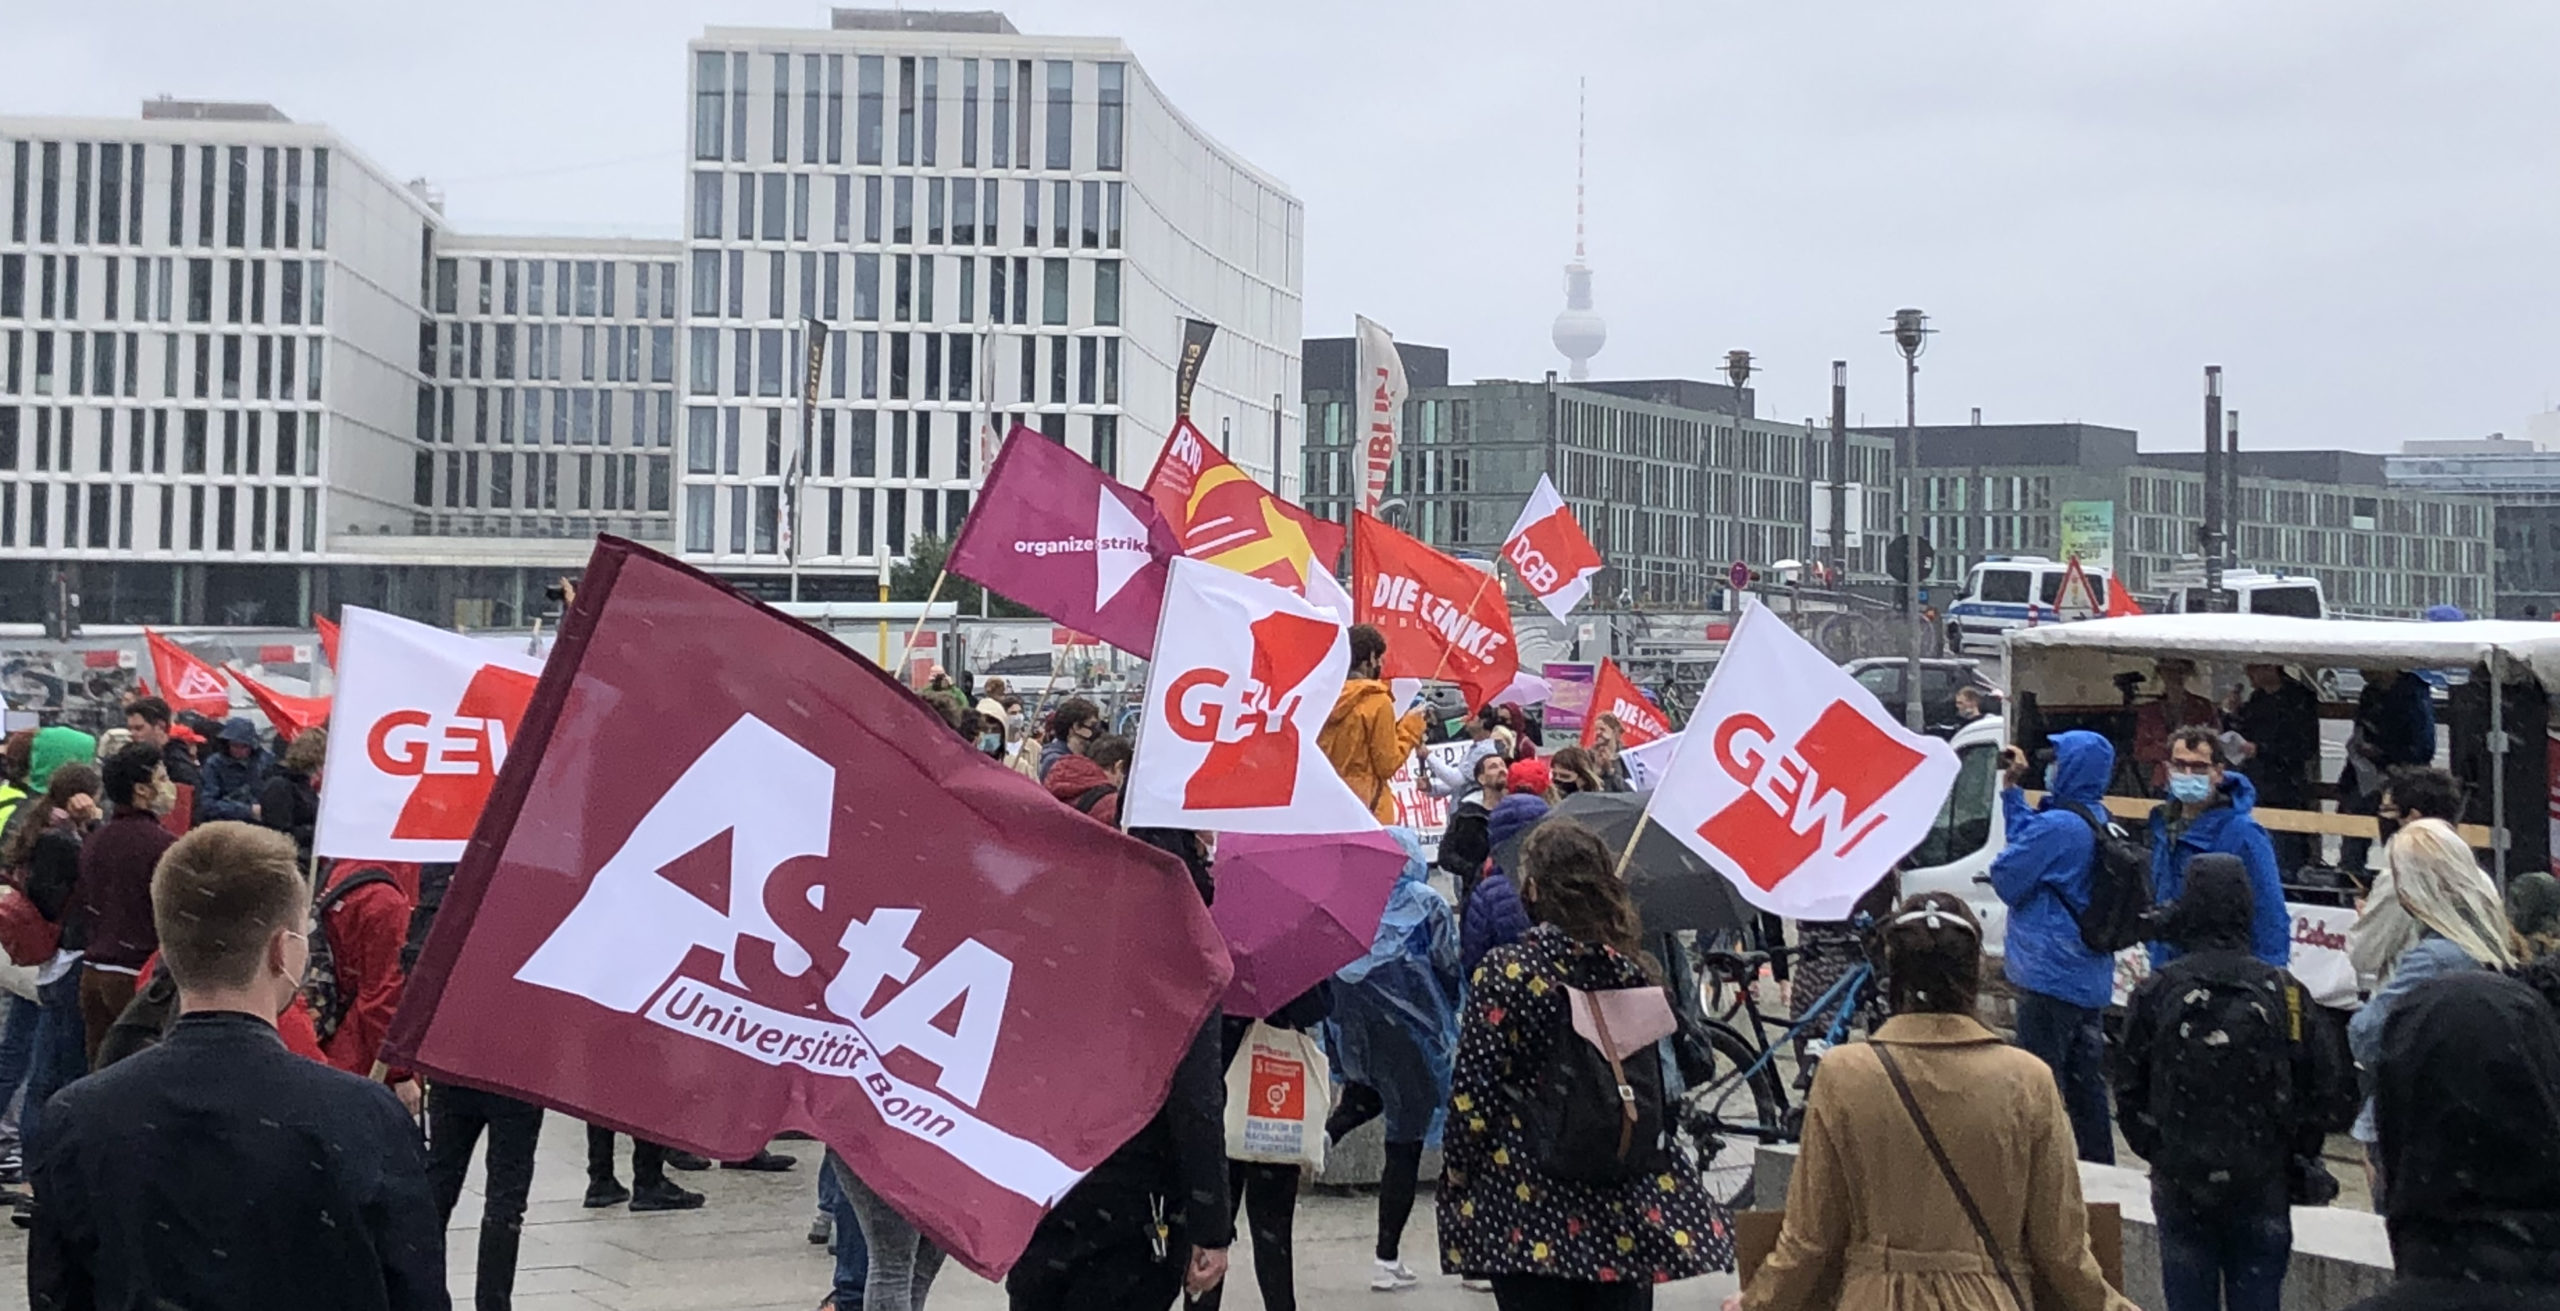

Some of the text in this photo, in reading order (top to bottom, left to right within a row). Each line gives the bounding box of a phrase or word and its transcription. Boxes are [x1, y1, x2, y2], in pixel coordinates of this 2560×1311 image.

[1372, 572, 1420, 612] DIE
[1511, 533, 1558, 593] DGB
[1613, 697, 1639, 726] DIE
[1713, 713, 1882, 860] GEW
[514, 713, 1012, 1107] AStA
[665, 986, 955, 1137] Universität Bonn
